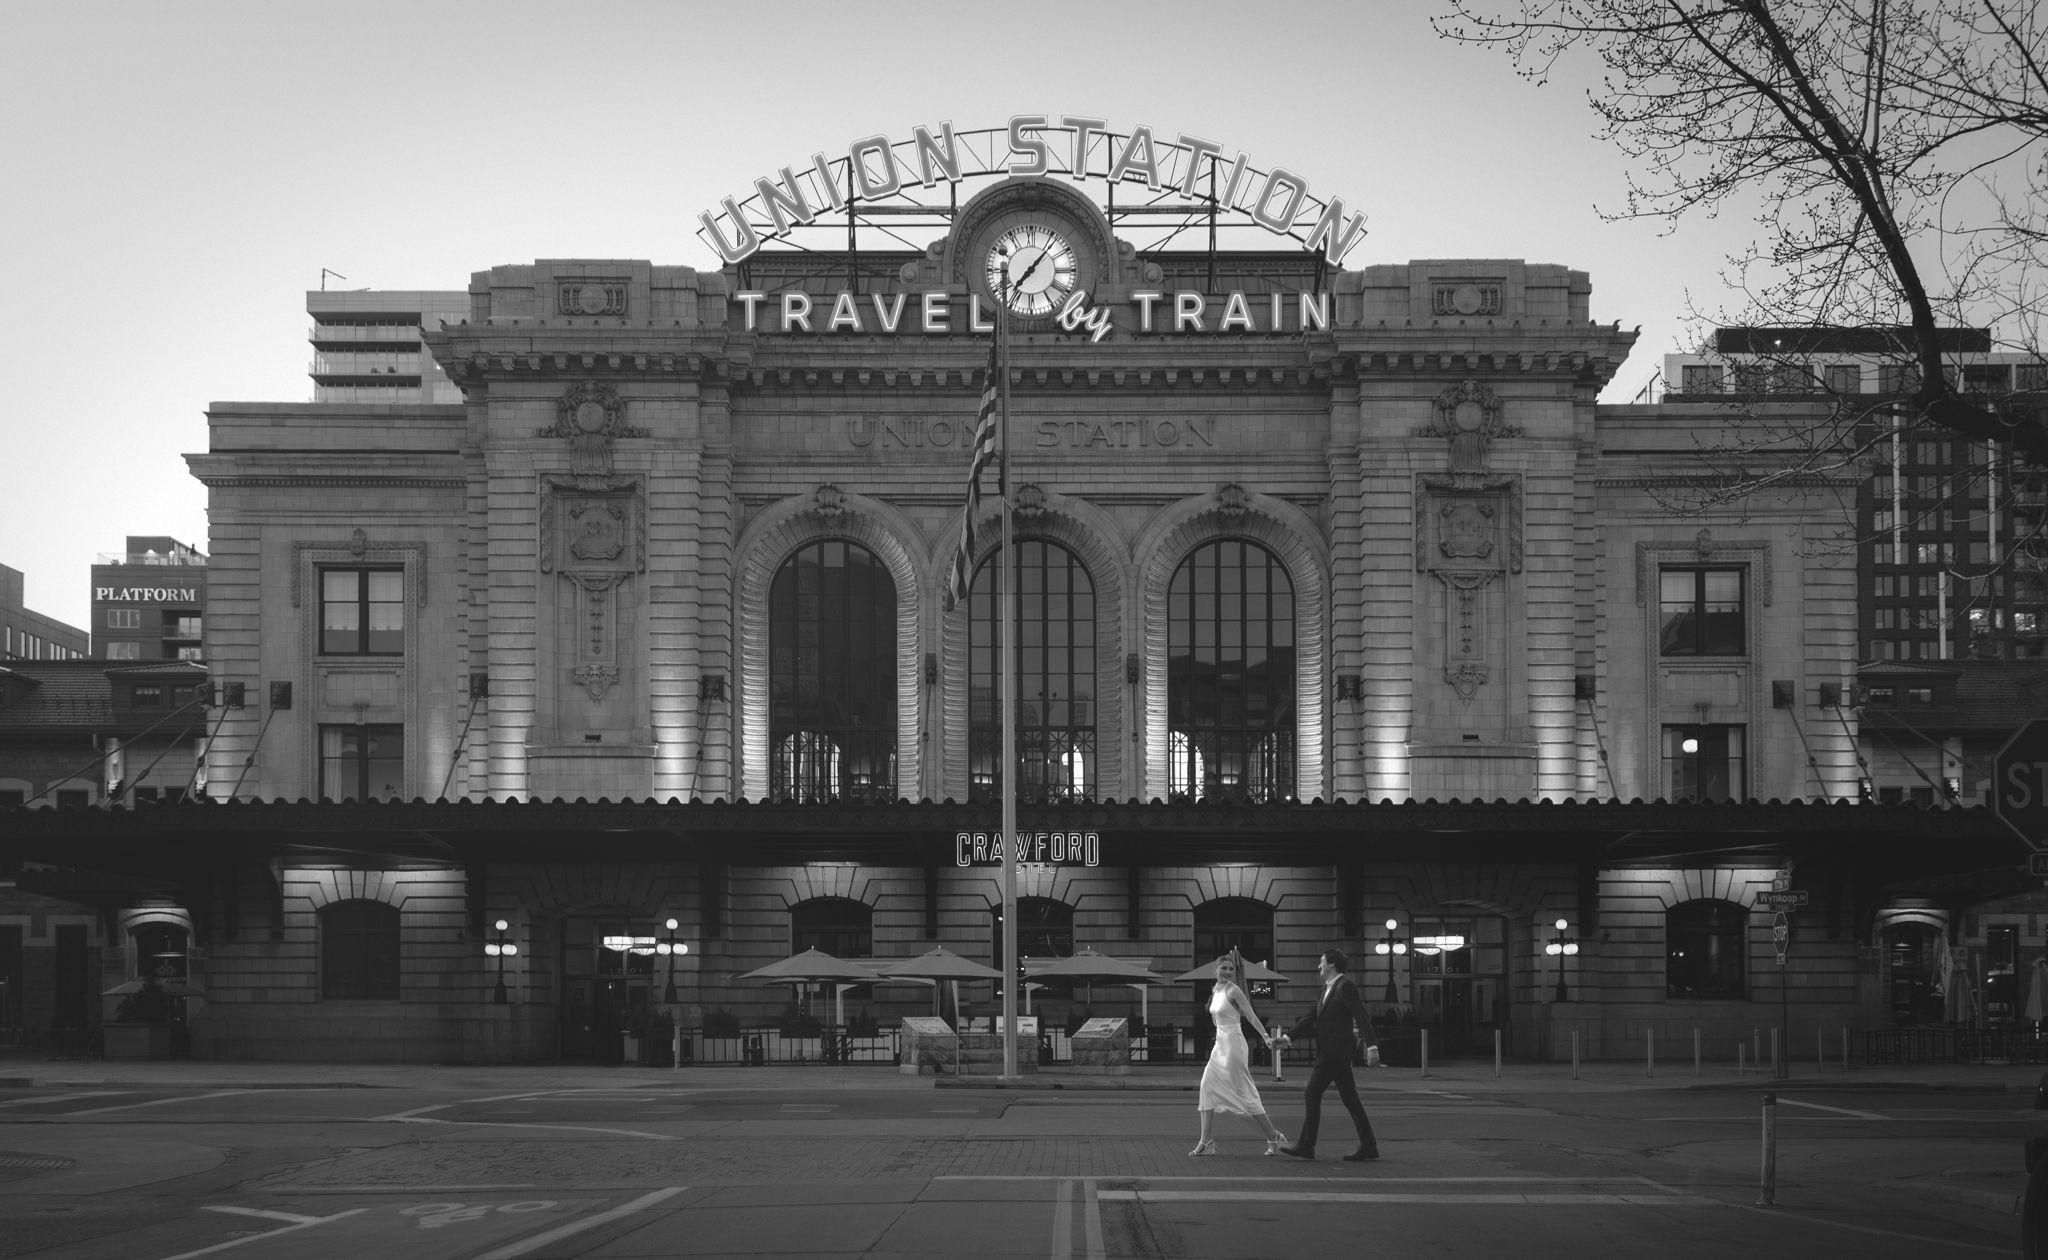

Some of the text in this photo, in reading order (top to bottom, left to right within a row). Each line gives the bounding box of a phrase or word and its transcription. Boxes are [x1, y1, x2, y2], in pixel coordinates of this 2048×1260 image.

[697, 114, 1368, 267] UNION STATION
[737, 288, 1330, 343] TRAVEL by TRAIN
[1036, 418, 1215, 449] STATION
[95, 587, 196, 602] PLATFORM
[956, 832, 1100, 867] CRAWFORD
[1001, 864, 1056, 874] OTEL
[1759, 891, 1798, 904] Wynkoop
[1774, 924, 1787, 942] STOP
